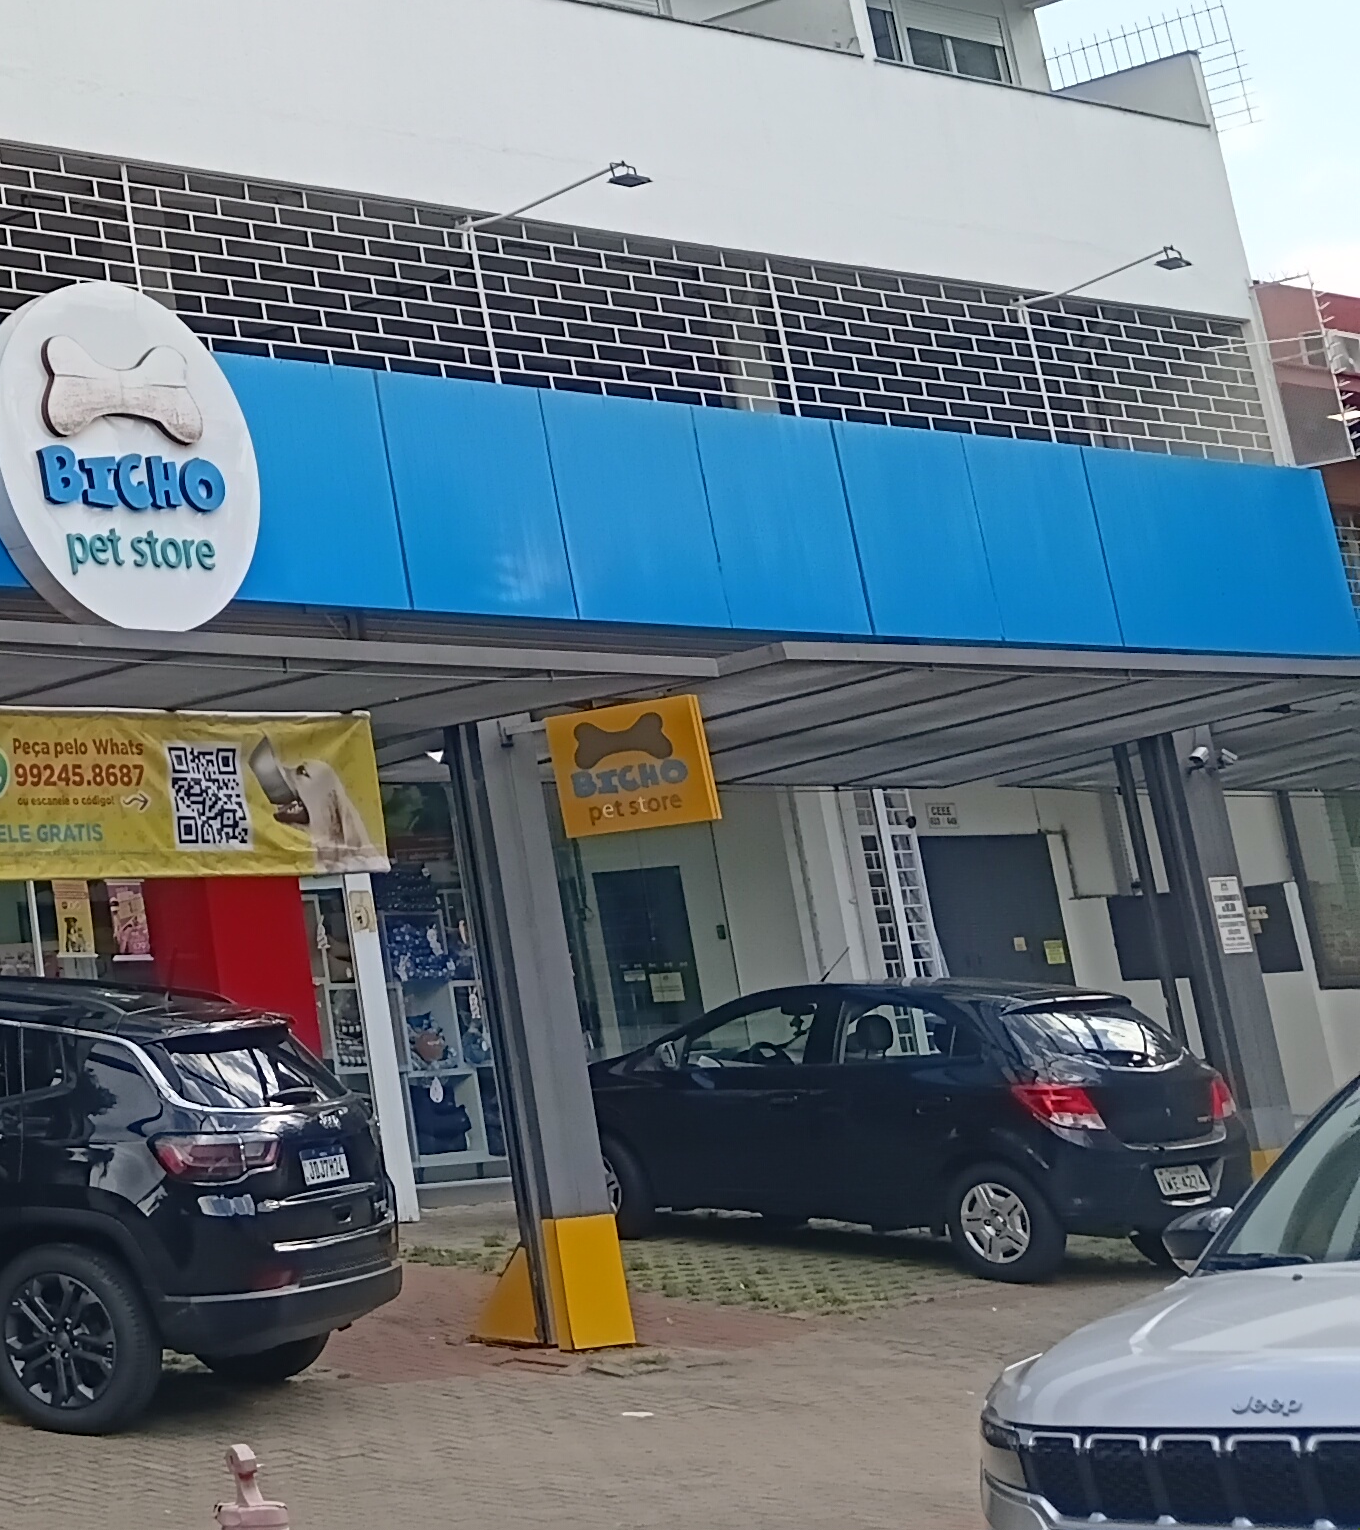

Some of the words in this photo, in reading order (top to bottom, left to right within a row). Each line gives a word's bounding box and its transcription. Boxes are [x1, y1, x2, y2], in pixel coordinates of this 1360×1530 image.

[35, 444, 226, 513] BICHO
[67, 527, 125, 575] pet
[131, 530, 216, 571] store
[12, 738, 50, 758] Peça
[54, 738, 88, 758] pelo
[92, 738, 144, 756] Whats
[14, 763, 145, 787] 99245.8687
[571, 758, 688, 798] BICHO
[72, 798, 79, 806] o
[589, 800, 625, 826] pet
[629, 793, 683, 816] store
[1231, 1396, 1304, 1417] Jeep
